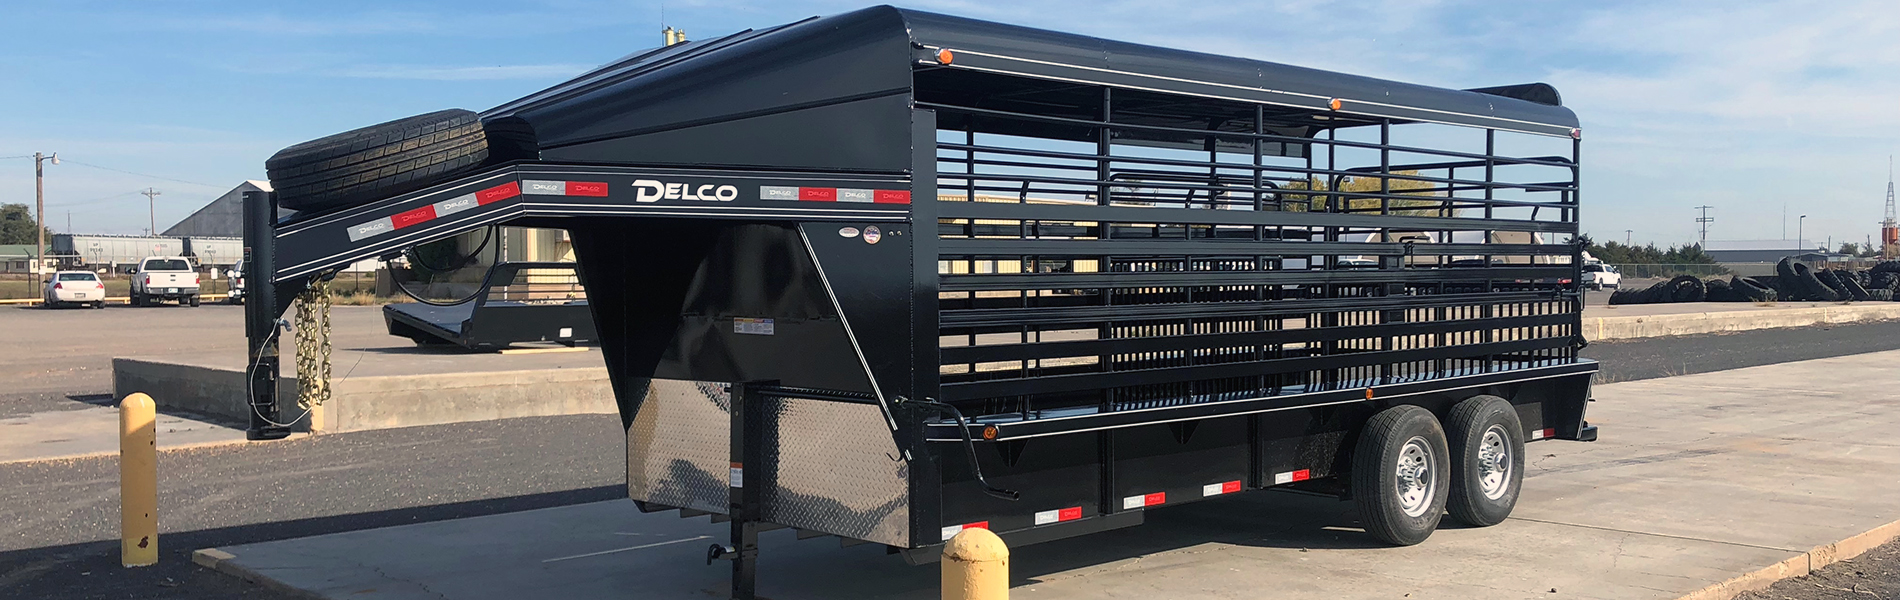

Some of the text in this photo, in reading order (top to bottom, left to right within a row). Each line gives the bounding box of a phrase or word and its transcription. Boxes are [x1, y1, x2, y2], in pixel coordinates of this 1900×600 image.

[485, 187, 511, 198] DELCO
[631, 179, 738, 203] DELCO
[443, 199, 469, 210] DELCO
[401, 210, 427, 222] DELCO
[358, 222, 384, 234] DELCO
